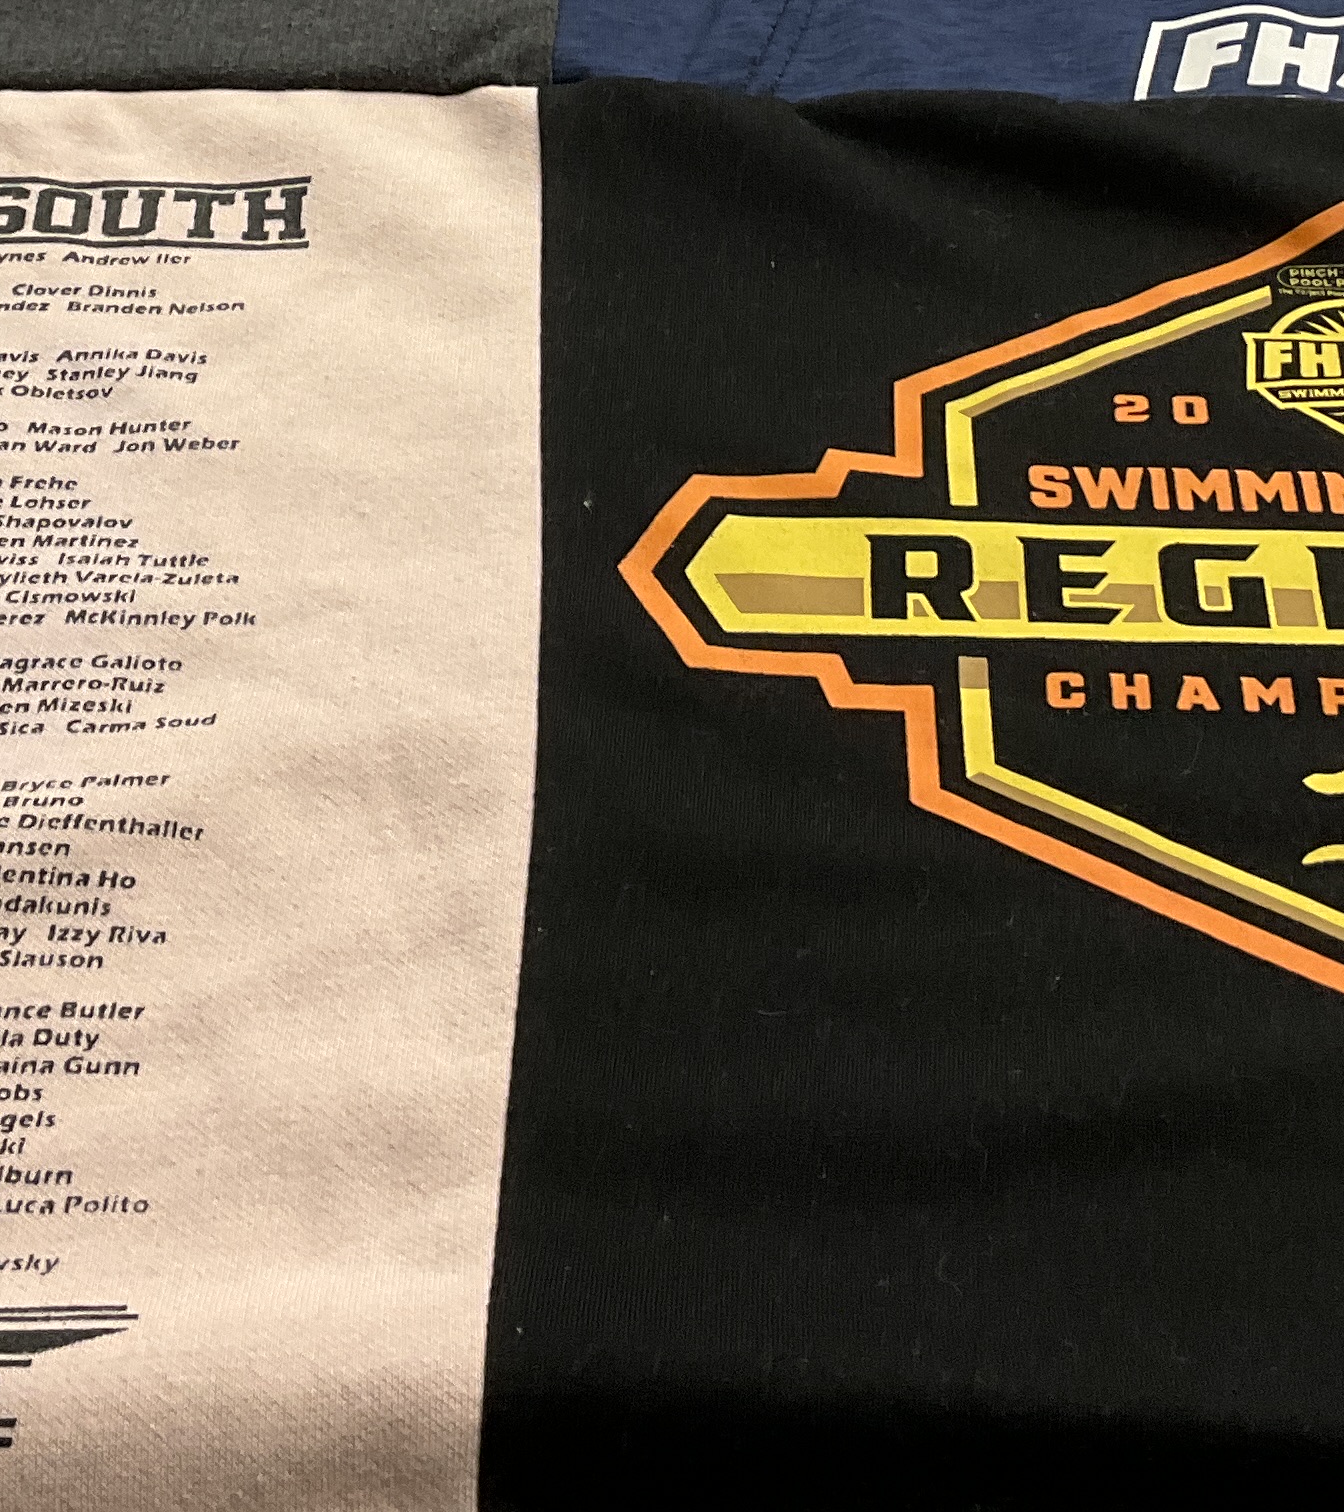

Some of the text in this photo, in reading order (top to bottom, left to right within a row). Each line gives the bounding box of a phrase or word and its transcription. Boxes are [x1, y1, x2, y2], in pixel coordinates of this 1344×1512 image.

[56, 349, 138, 362] Annika
[146, 349, 206, 364] Davis
[1113, 393, 1211, 427] 20
[64, 1056, 139, 1075] Gunn
